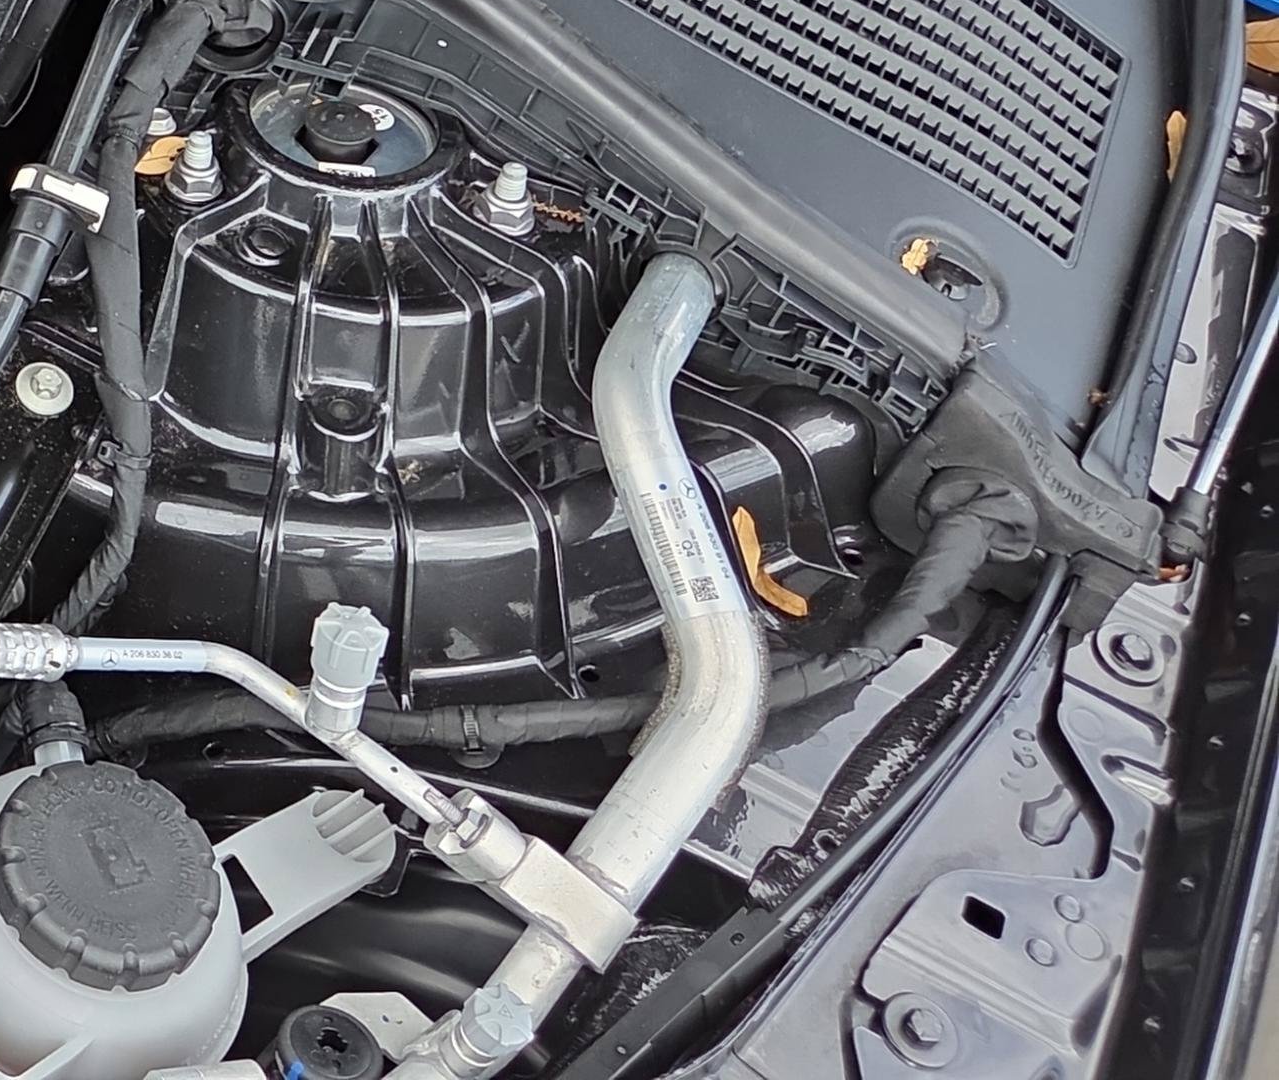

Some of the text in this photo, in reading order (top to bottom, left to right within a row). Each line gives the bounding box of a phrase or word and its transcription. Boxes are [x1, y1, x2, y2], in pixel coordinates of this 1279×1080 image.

[682, 540, 695, 558] Q4
[91, 776, 118, 795] DO
[154, 808, 193, 850] OPEN
[45, 879, 86, 921] WENN
[89, 916, 139, 941] HEISS
